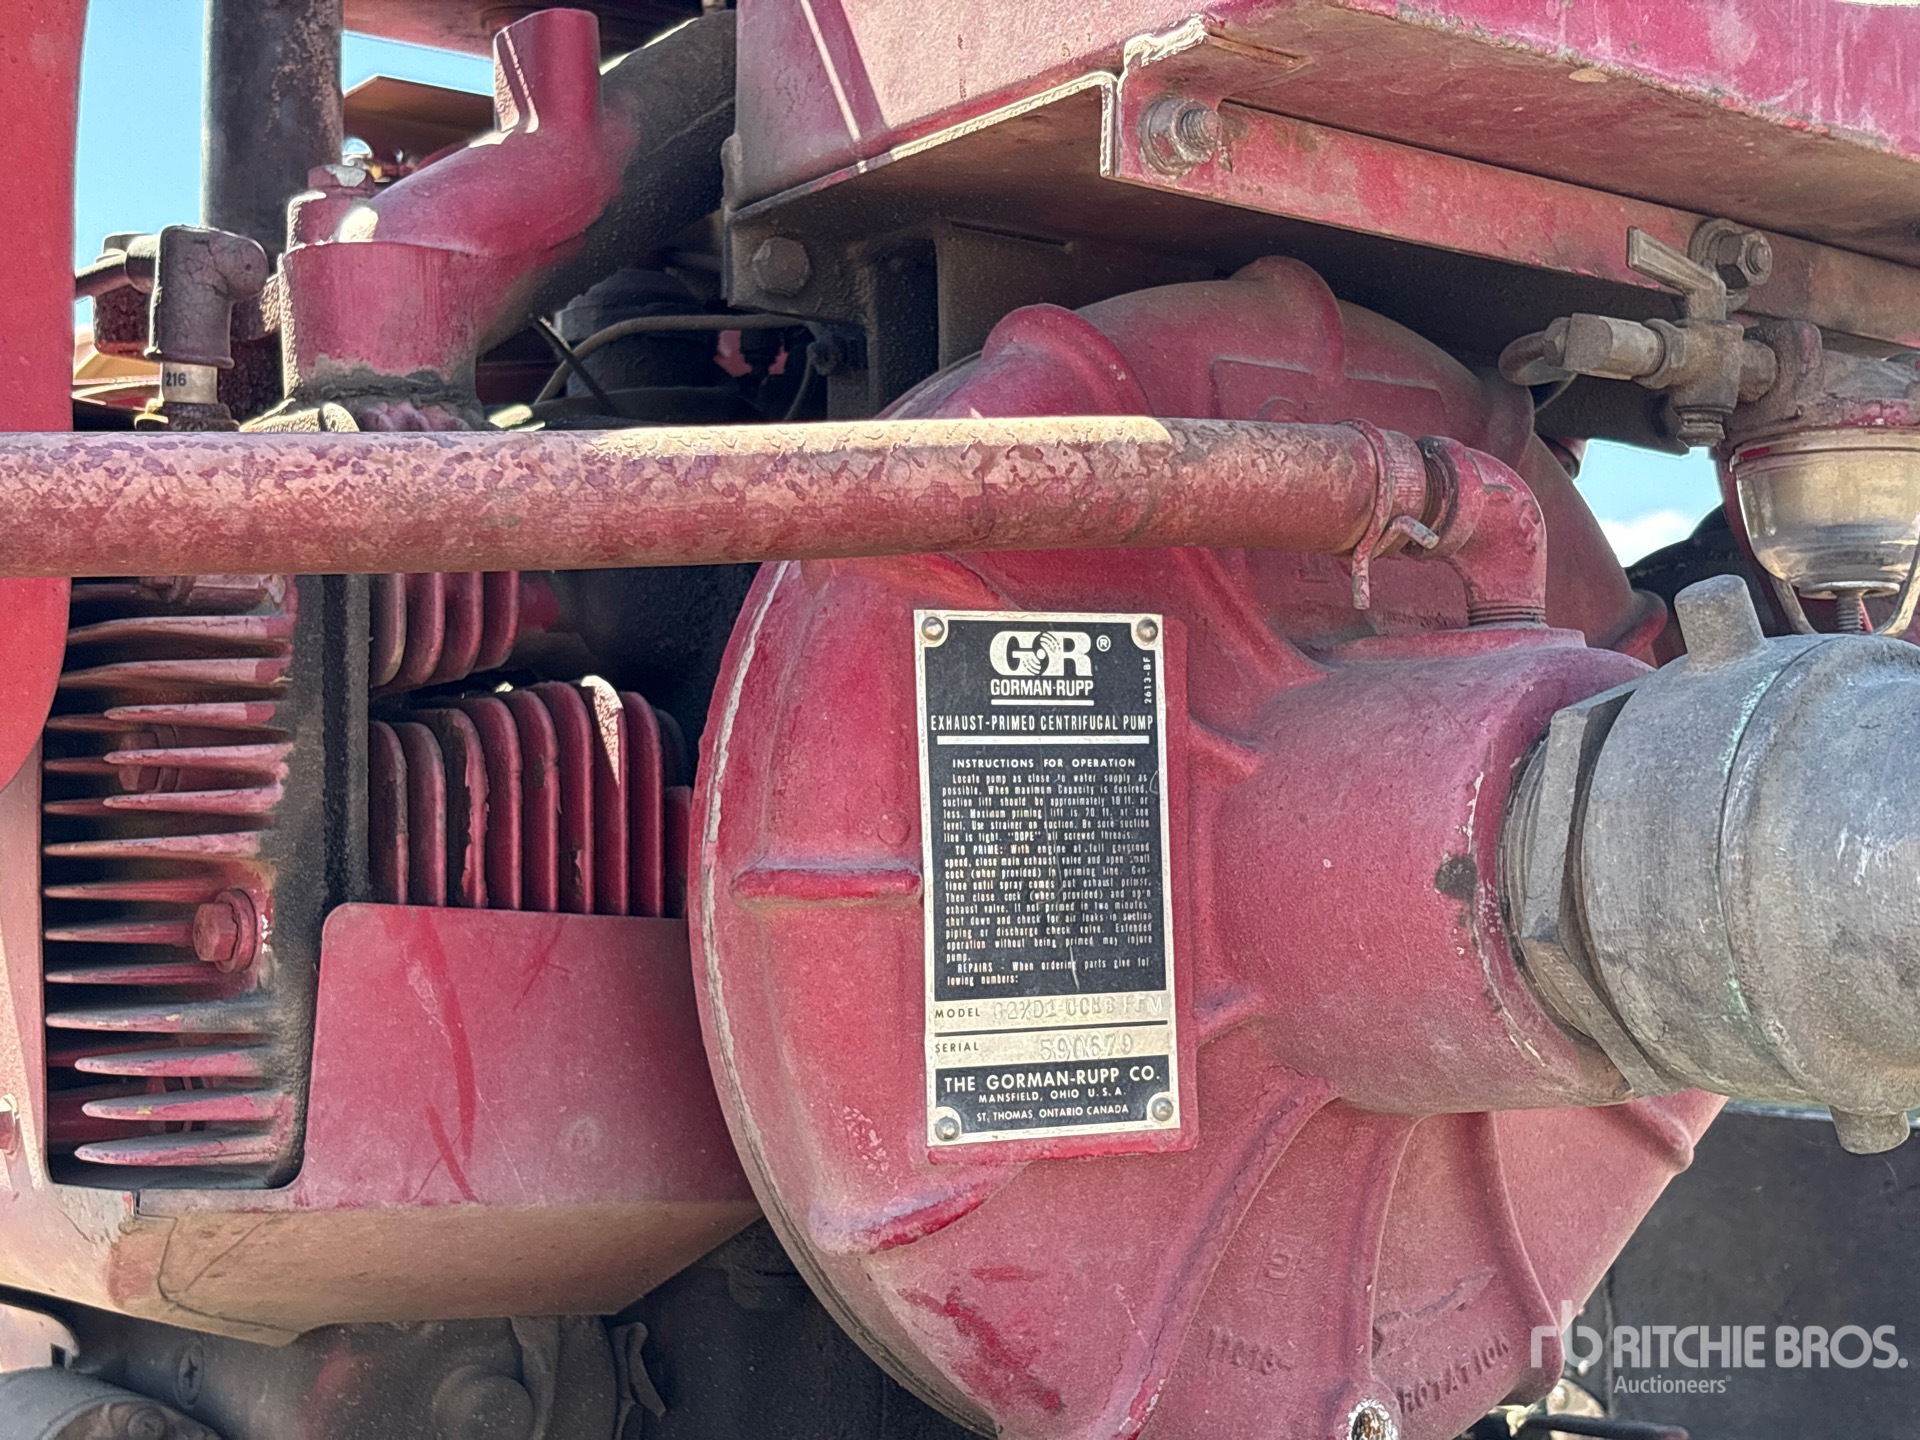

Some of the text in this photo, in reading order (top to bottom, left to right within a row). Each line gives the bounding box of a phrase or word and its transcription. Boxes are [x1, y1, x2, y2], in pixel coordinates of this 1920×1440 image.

[166, 372, 187, 387] 216
[1142, 656, 1152, 704] 2613-BF
[931, 715, 1153, 731] EXHAUST-PRIMED CENTRIFUGAL PUMP
[952, 758, 1136, 768] INSTRUCTIONS FOR OPERATION
[1132, 889, 1151, 899] opn
[958, 962, 993, 973] REPAIRS
[935, 1008, 980, 1018] MODEL
[935, 1044, 979, 1053] SERIAL
[944, 1065, 1160, 1092] THE GORMAN-RUPP CO.
[979, 1092, 1043, 1103] MANSFIELD,
[1050, 1089, 1079, 1099] OHIO
[1039, 1107, 1083, 1118] ONTARIO
[1087, 1104, 1129, 1115] CANADA
